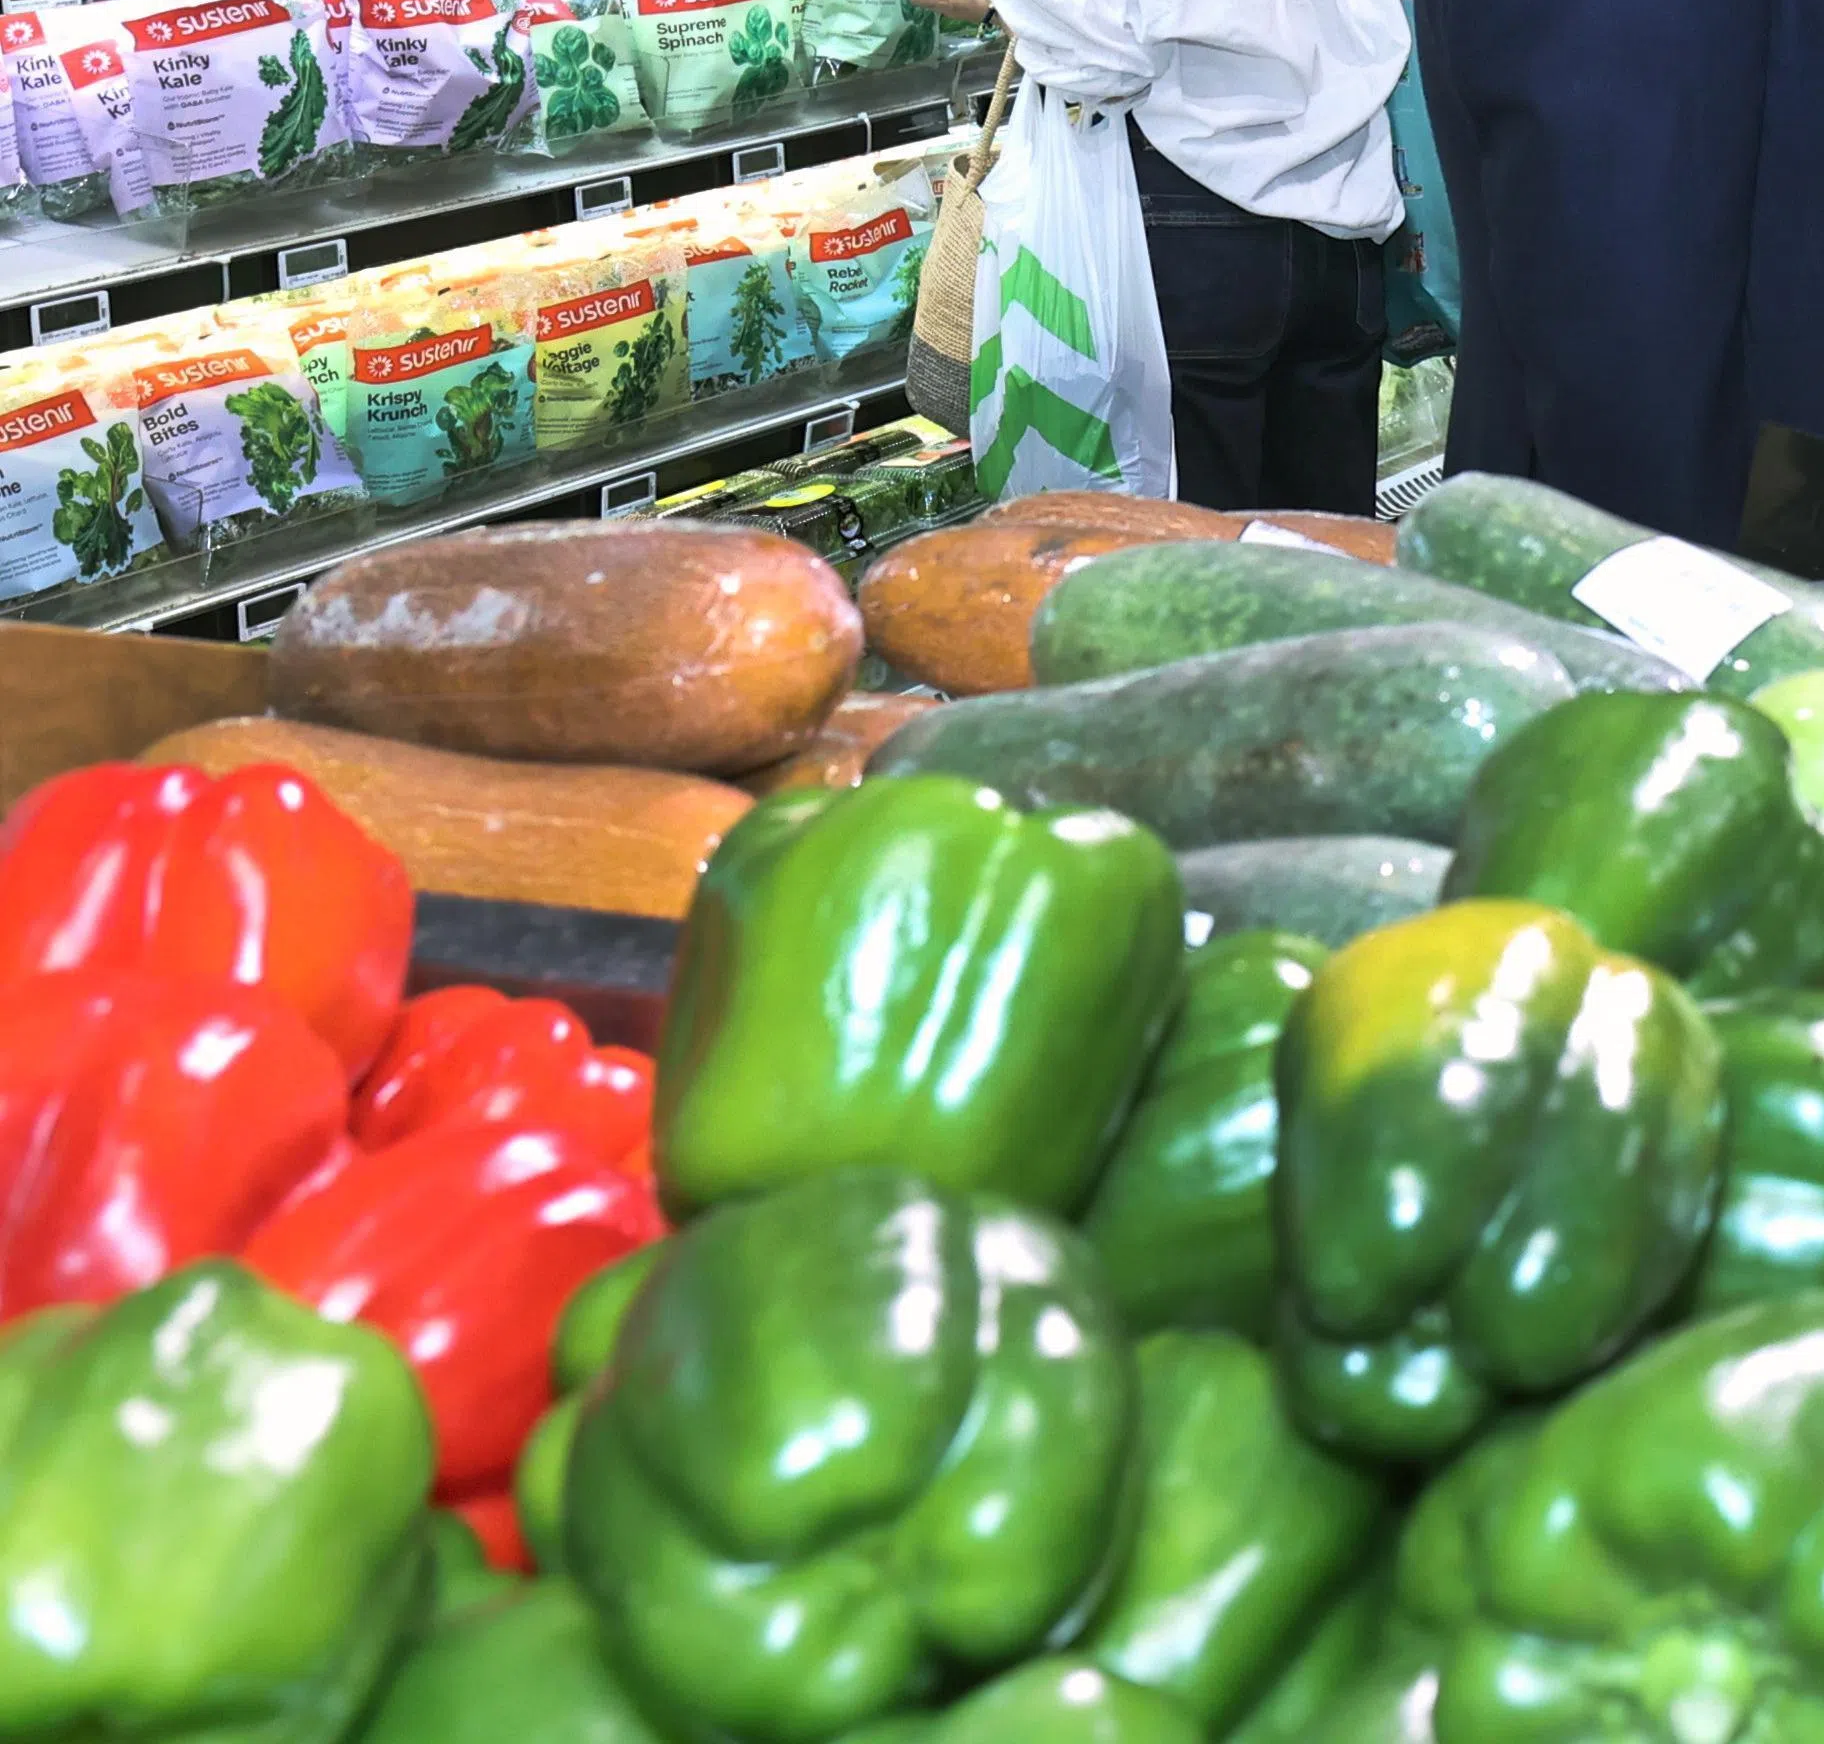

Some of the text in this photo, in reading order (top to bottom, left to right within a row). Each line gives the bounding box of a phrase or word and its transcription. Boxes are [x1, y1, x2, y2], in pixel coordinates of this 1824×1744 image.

[656, 17, 727, 38] Supreme
[375, 38, 427, 53] Kinky
[658, 32, 723, 51] Spinach
[153, 54, 210, 73] Kinky
[20, 73, 62, 91] Kale
[158, 73, 202, 89] Kale
[829, 277, 868, 293] Rocket
[545, 343, 592, 363] eggie
[368, 390, 422, 408] Krispy
[143, 403, 188, 432] Bold
[368, 404, 427, 422] Krunch
[149, 420, 199, 446] Bites
